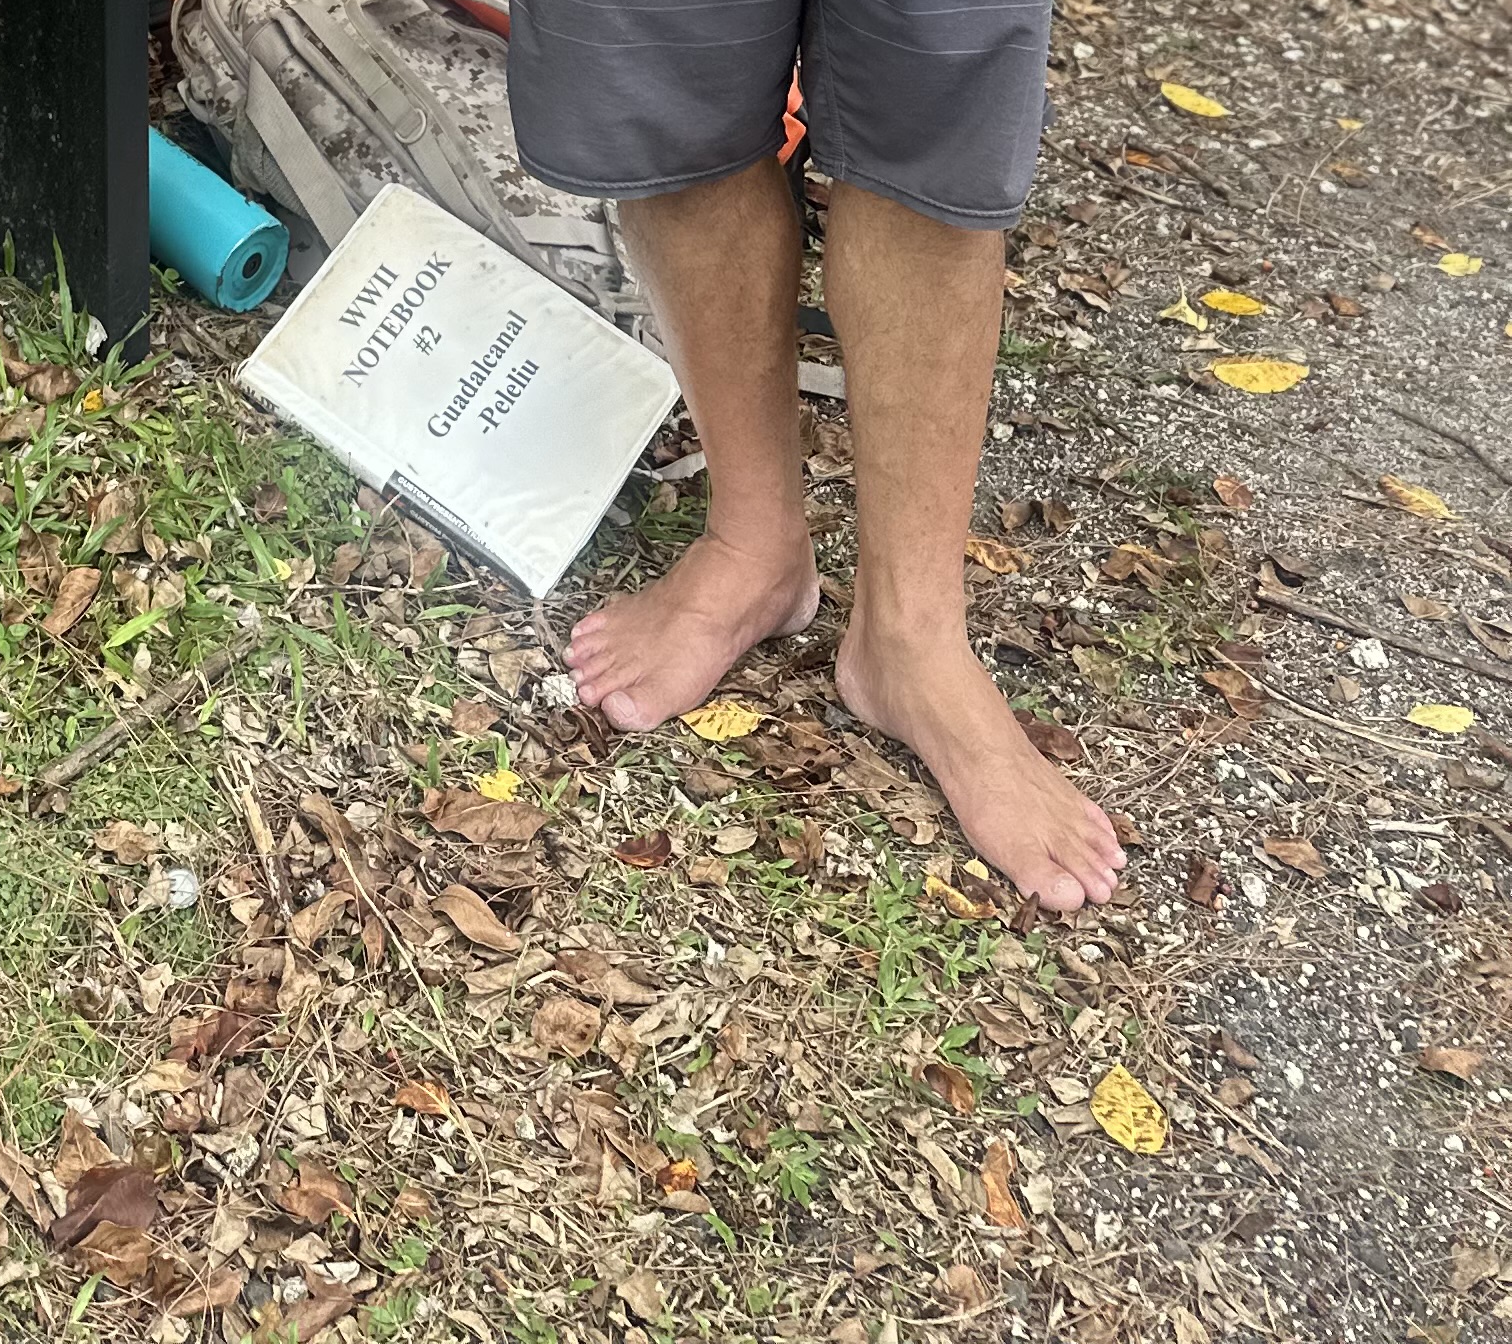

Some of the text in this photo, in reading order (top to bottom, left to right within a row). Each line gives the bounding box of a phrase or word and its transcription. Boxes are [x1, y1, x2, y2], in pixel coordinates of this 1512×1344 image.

[338, 262, 400, 328] WWII
[342, 251, 453, 388] NOTEBOOK
[413, 325, 442, 356] #2
[427, 309, 528, 438] Guadalcanal
[477, 359, 540, 434] -Peleliu
[398, 476, 430, 503] CUSTOM
